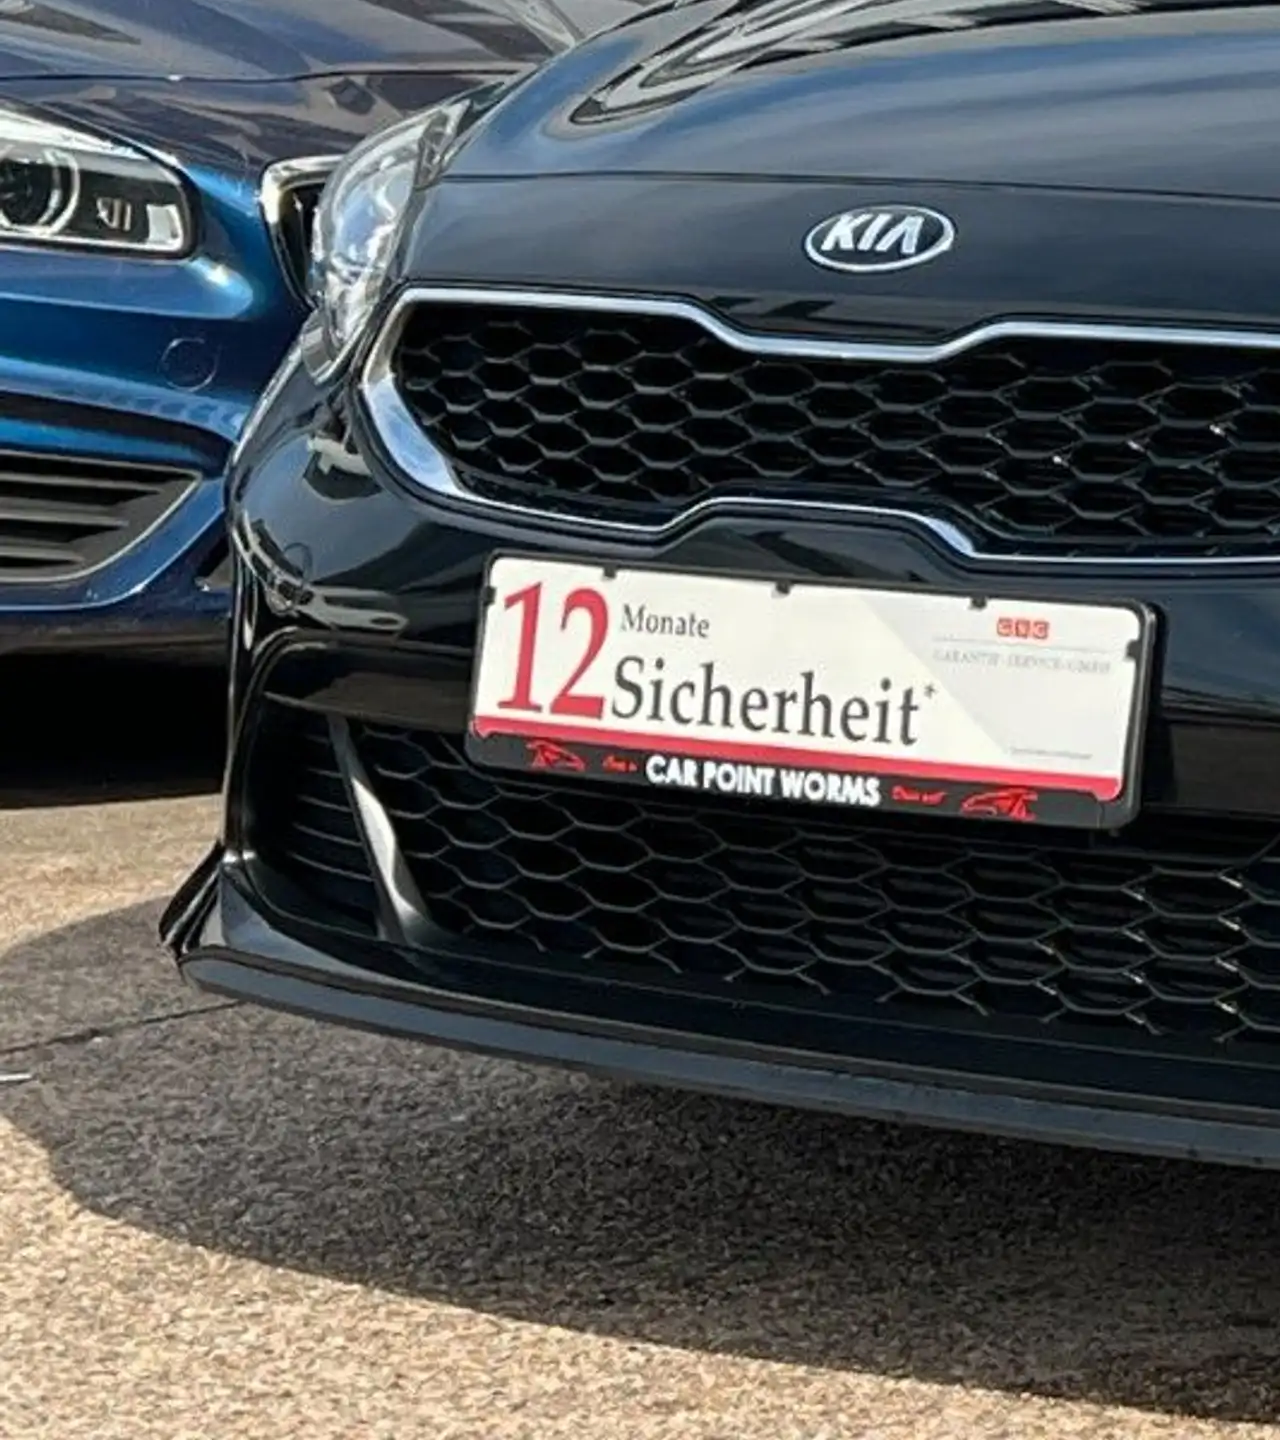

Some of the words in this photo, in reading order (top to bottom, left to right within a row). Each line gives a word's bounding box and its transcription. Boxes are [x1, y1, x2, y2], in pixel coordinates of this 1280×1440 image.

[820, 213, 925, 254] KIA
[498, 581, 609, 720] 12
[620, 603, 710, 639] Monate
[645, 754, 698, 788] CAR
[703, 761, 777, 797] POINT
[779, 768, 882, 808] WORMS
